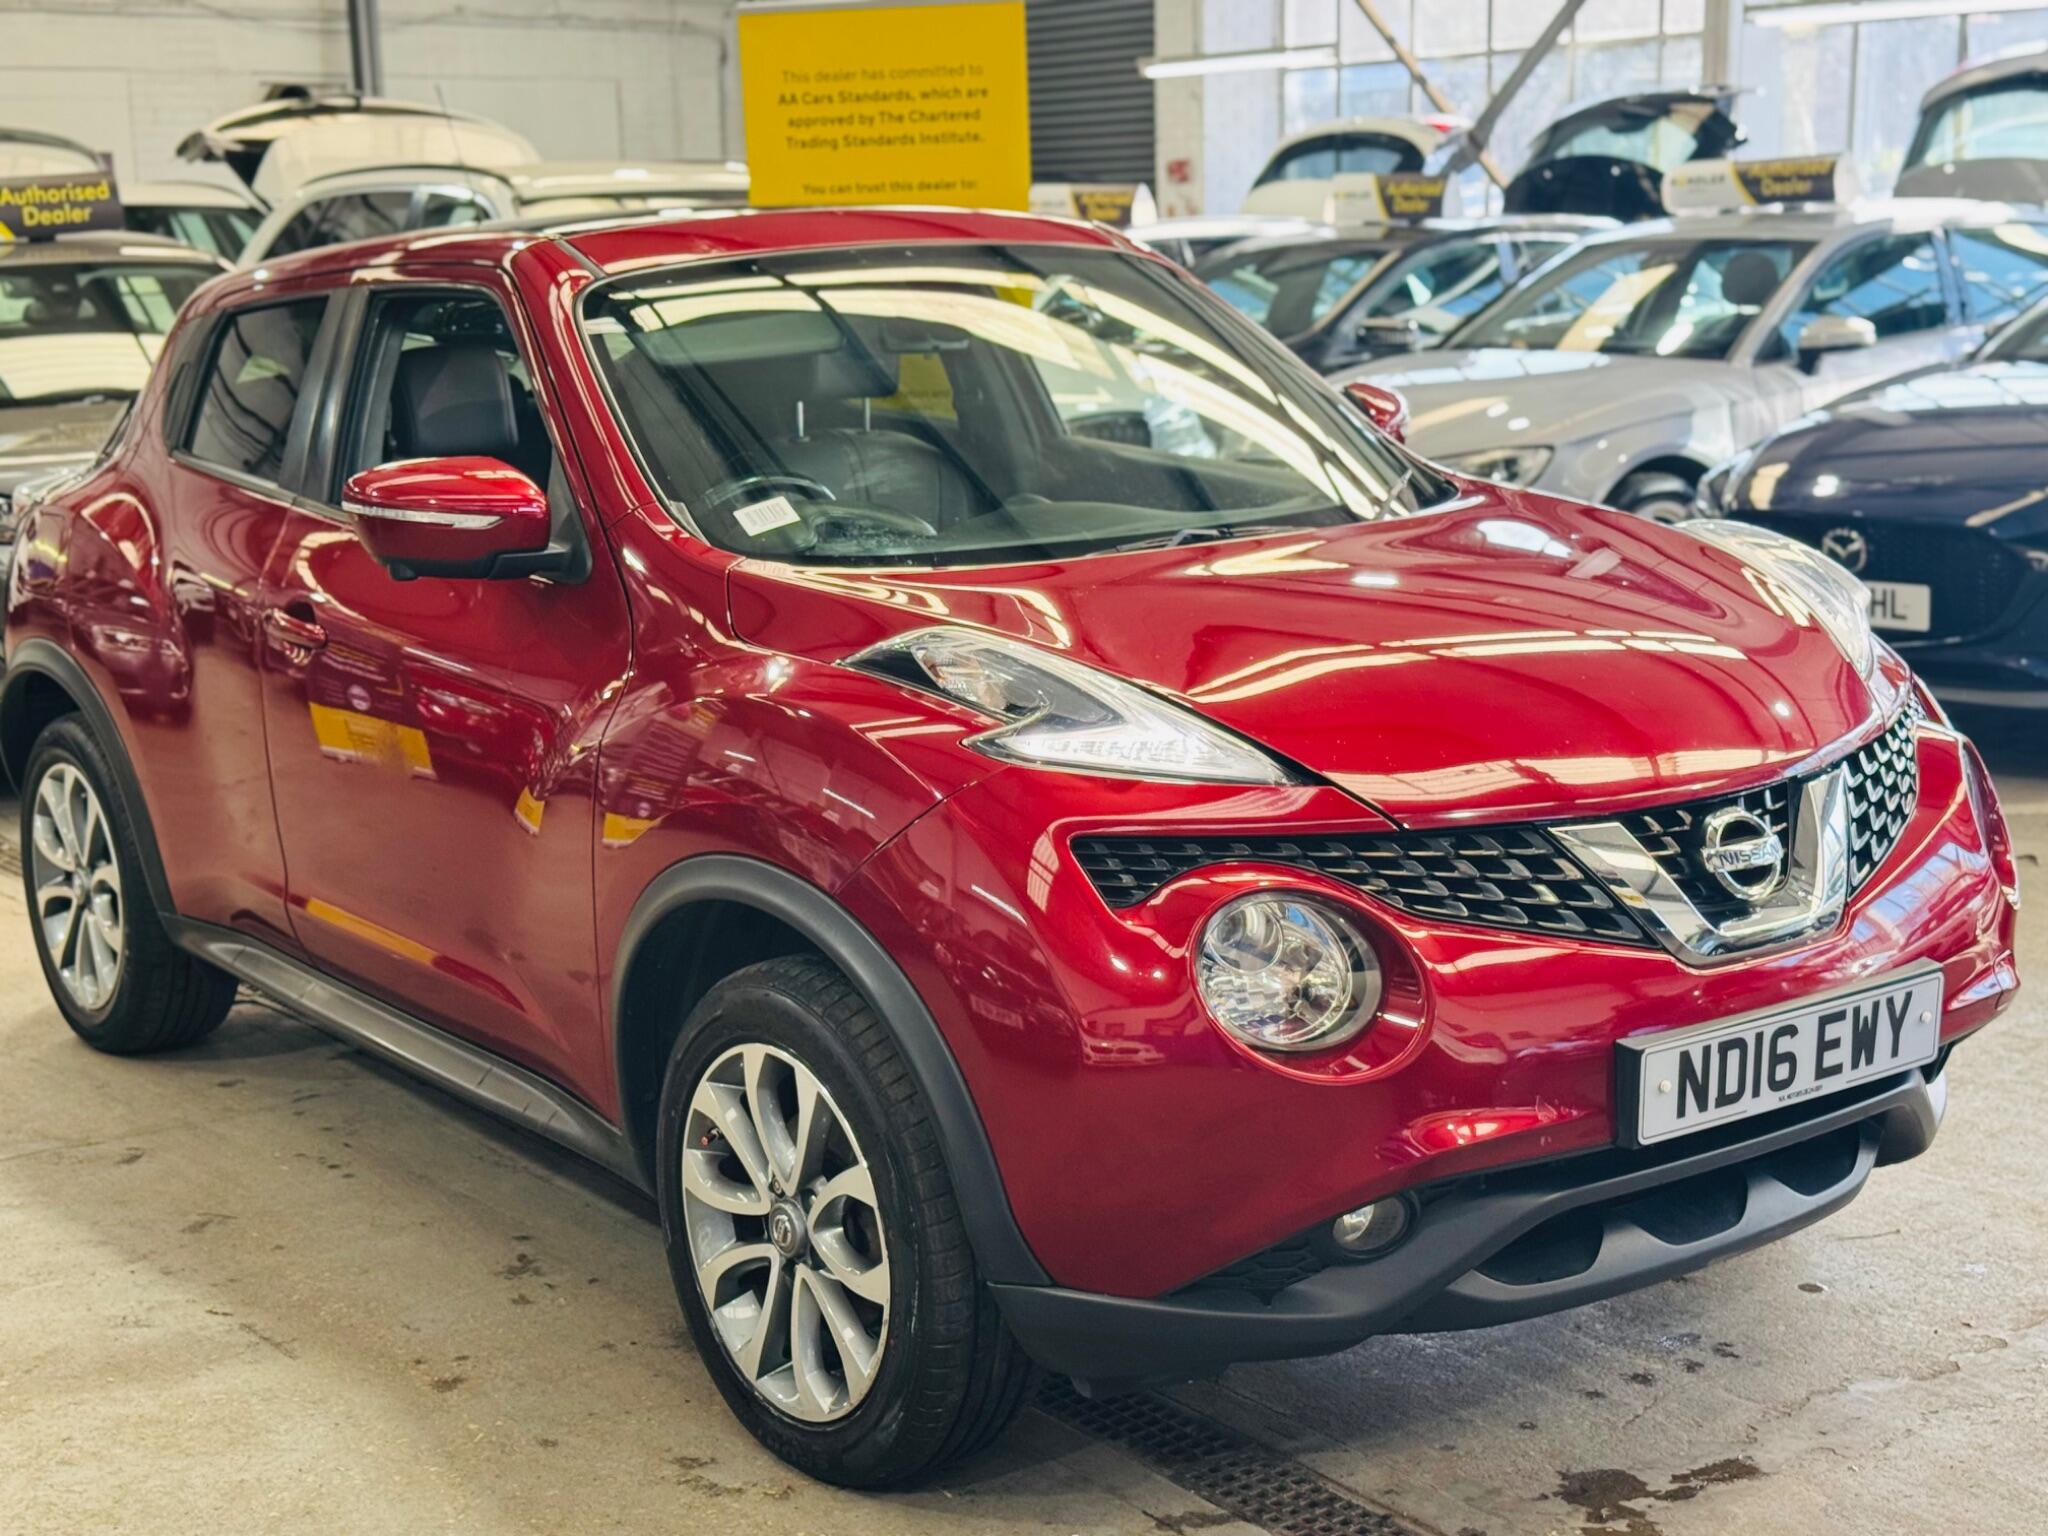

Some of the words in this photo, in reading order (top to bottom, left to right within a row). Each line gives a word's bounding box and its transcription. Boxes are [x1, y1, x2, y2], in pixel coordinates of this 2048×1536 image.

[778, 92, 798, 105] AA
[802, 91, 834, 104] Cars
[920, 85, 962, 99] which
[966, 87, 988, 98] are
[787, 114, 854, 129] approved
[858, 113, 875, 127] by
[879, 110, 905, 123] The
[909, 108, 981, 122] Chartered
[785, 134, 838, 151] Trading
[843, 134, 916, 147] Standards
[0, 180, 110, 205] Authorised
[802, 182, 826, 195] You
[829, 184, 852, 194] can
[856, 181, 887, 193] trust
[890, 179, 913, 192] this
[918, 179, 957, 191] dealer
[22, 203, 93, 226] Dealer
[1871, 587, 1907, 620] HL
[1719, 842, 1780, 867] NISSAN
[1676, 1023, 1799, 1119] ND16
[1814, 991, 1913, 1081] EWY
